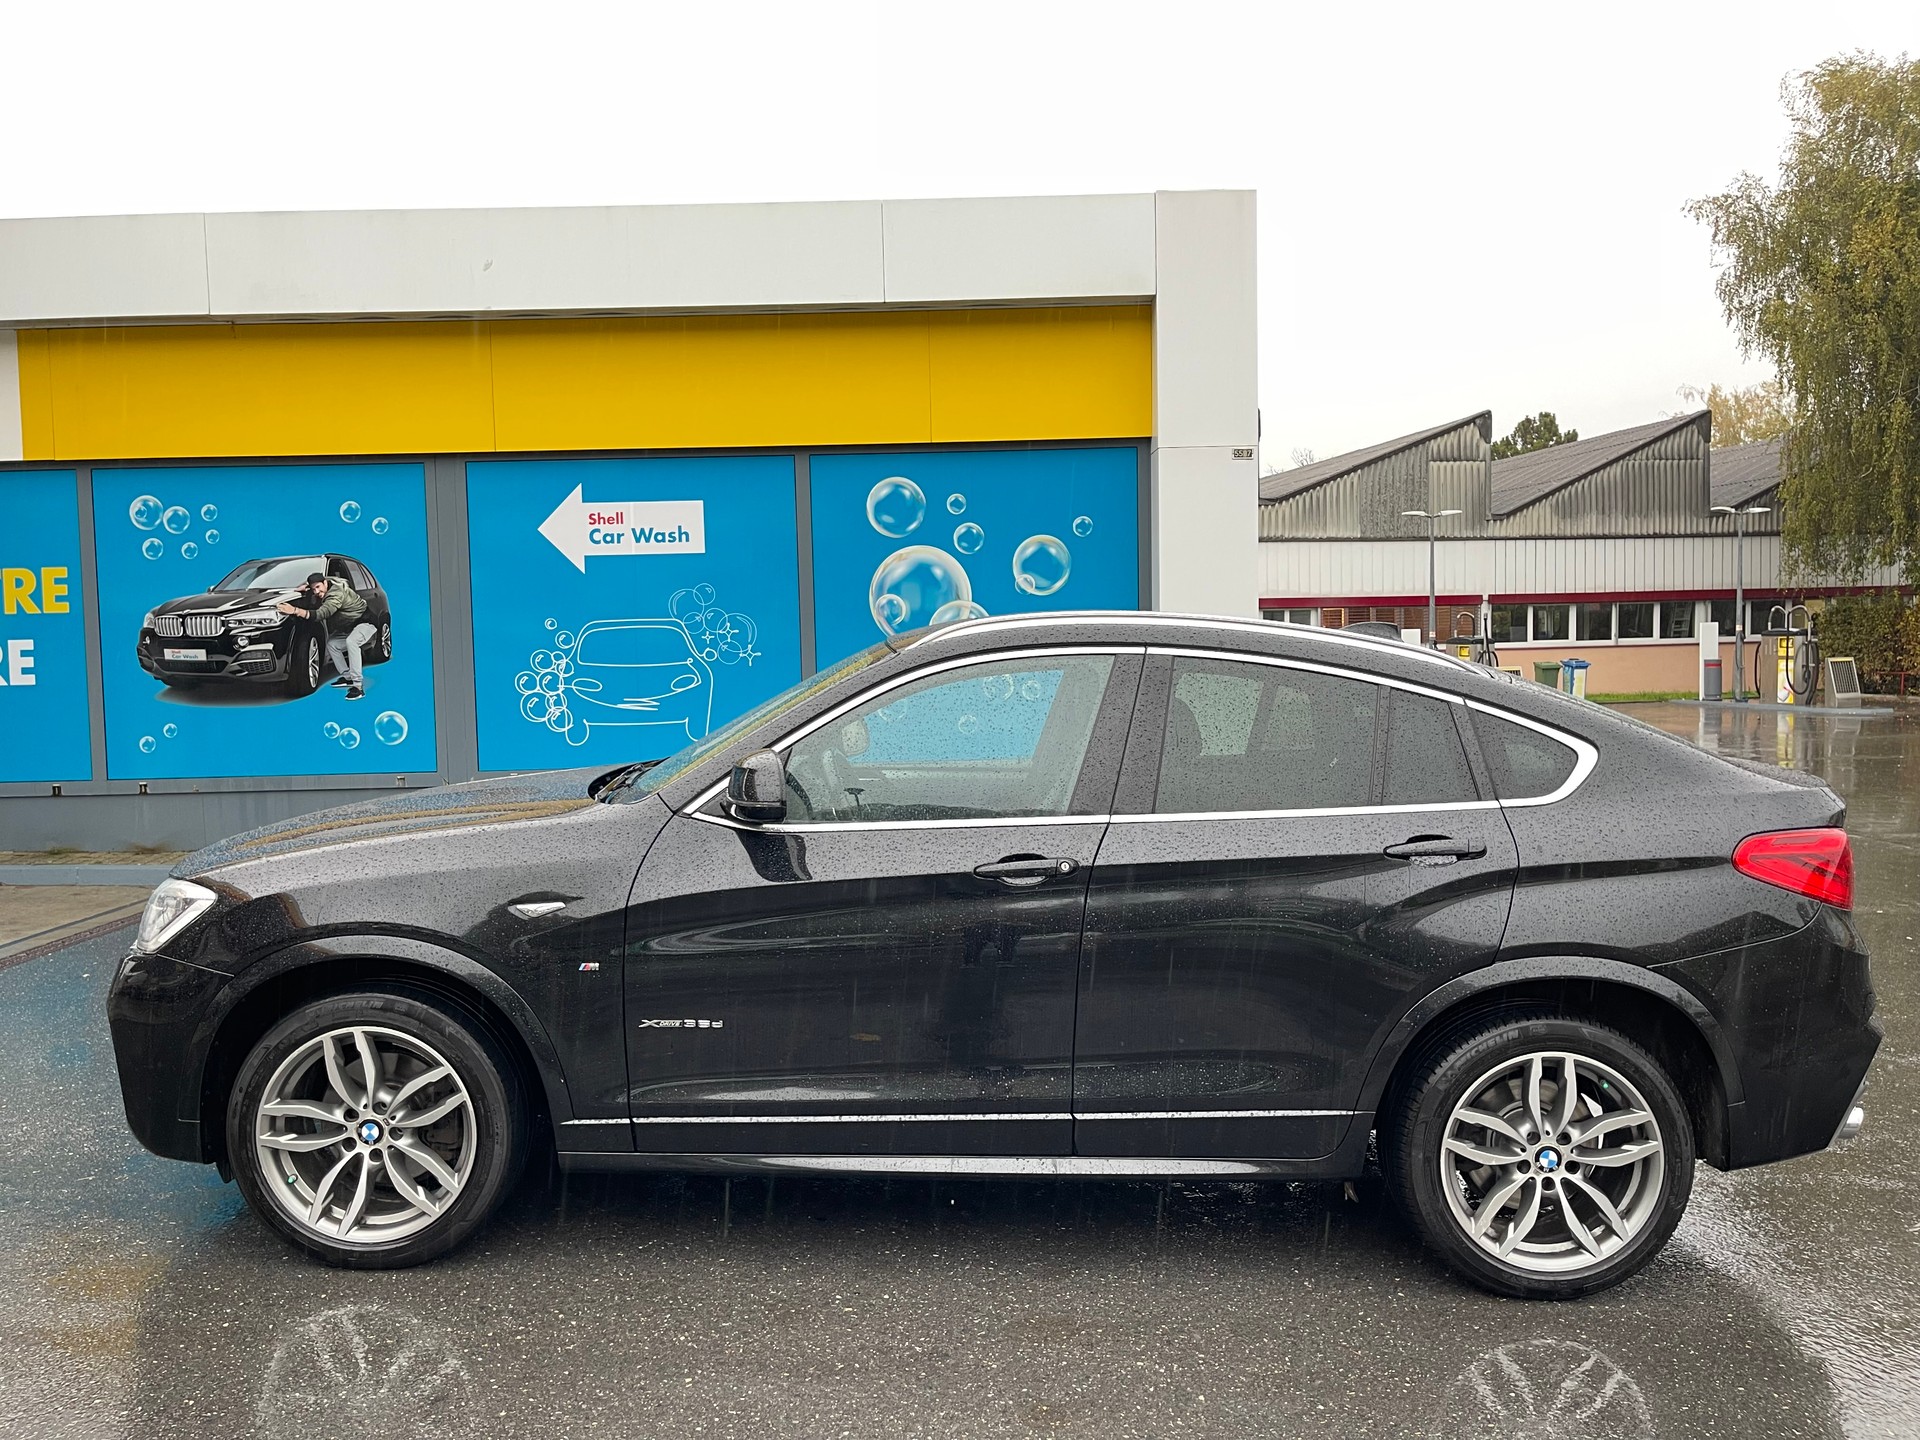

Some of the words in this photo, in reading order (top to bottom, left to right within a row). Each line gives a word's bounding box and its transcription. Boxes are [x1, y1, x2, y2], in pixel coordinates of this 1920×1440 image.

[588, 511, 624, 526] Shell
[588, 528, 625, 545] Car
[631, 525, 690, 544] Wash
[0, 566, 70, 615] RE
[0, 639, 36, 686] E
[1455, 1028, 1519, 1069] MICHELIN
